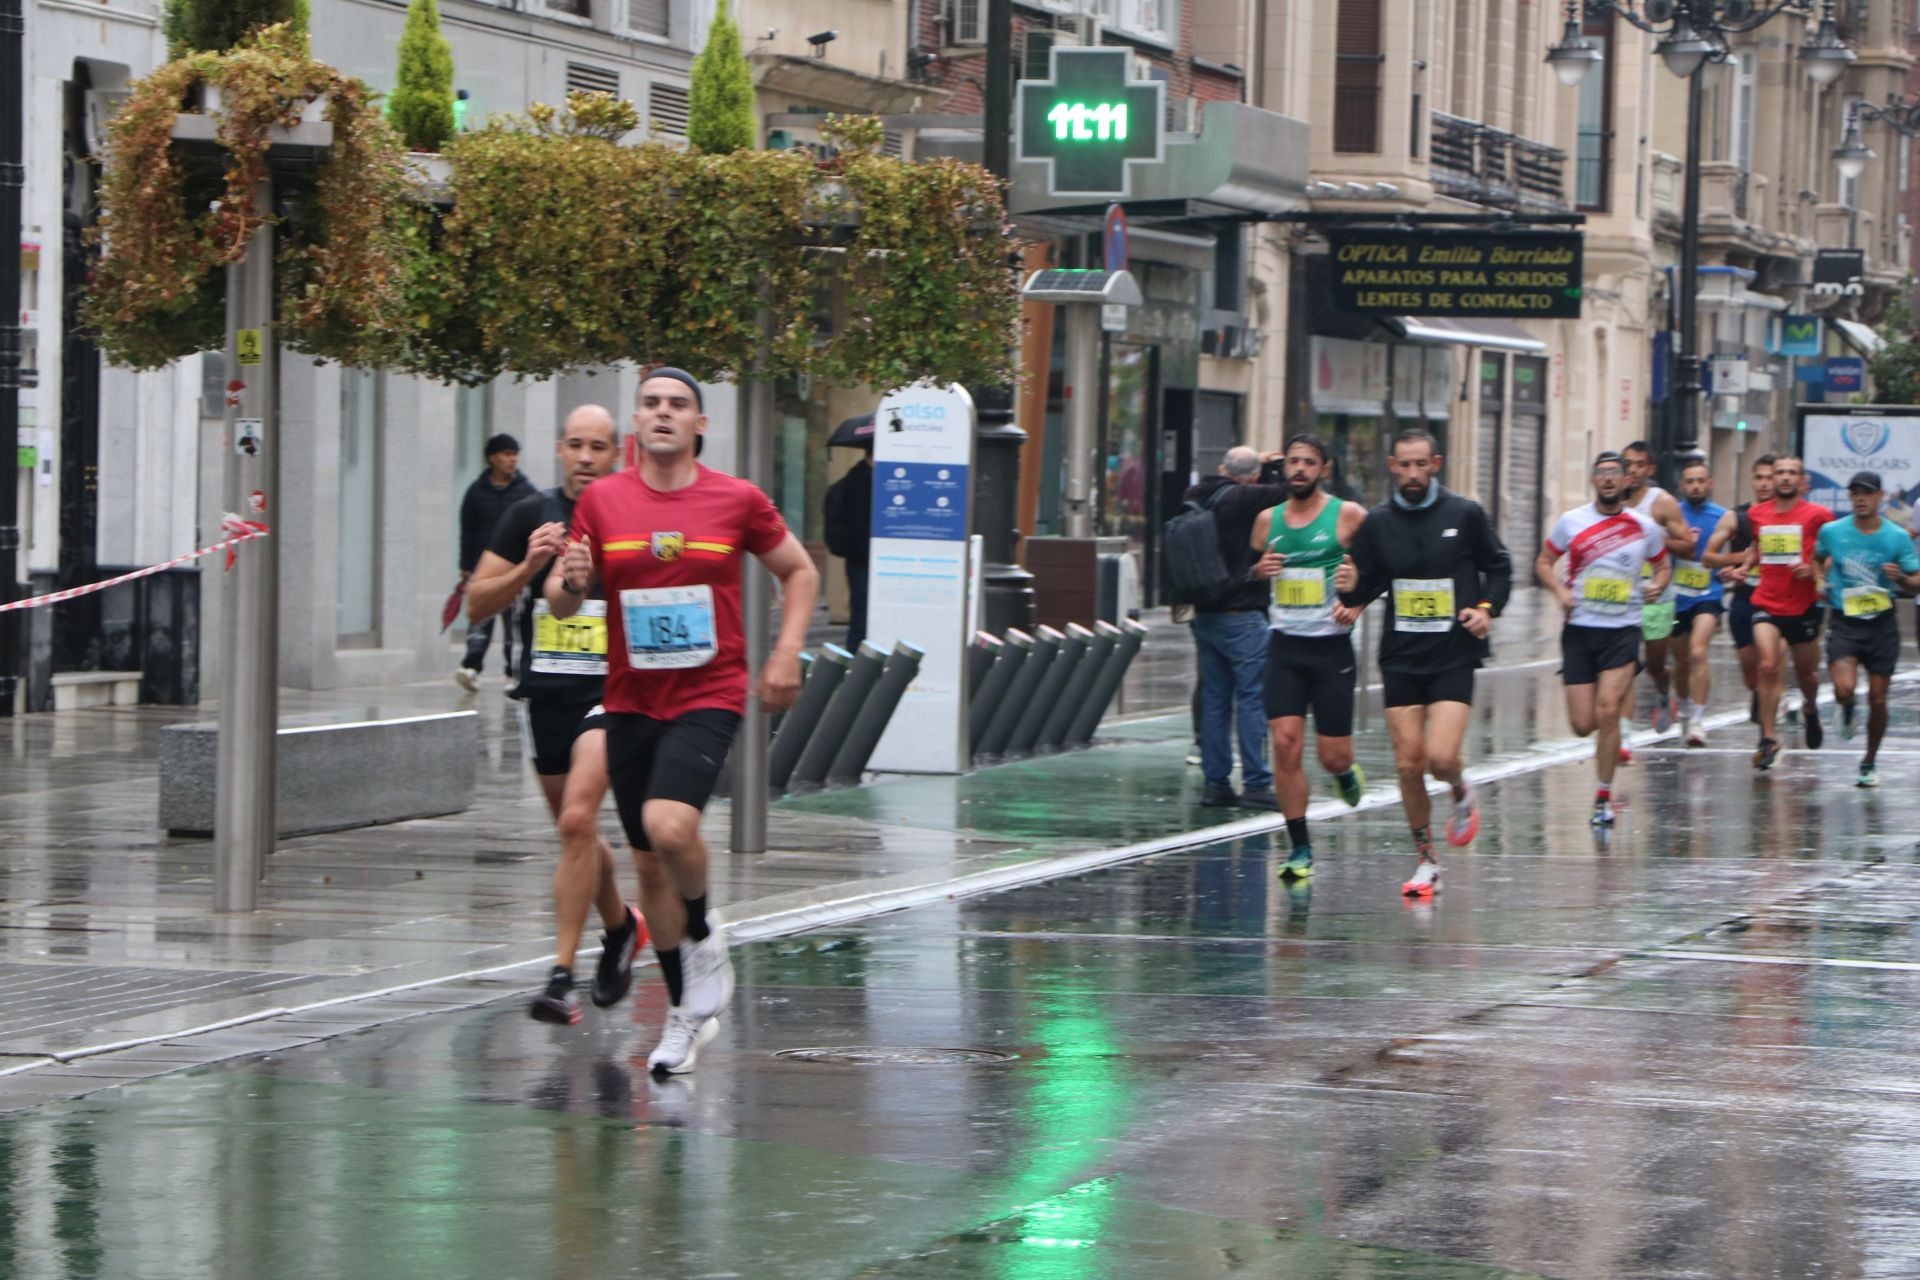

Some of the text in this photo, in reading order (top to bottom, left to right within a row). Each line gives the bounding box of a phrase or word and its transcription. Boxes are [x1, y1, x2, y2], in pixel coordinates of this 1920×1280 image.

[1047, 102, 1127, 139] 11:11
[1337, 244, 1574, 265] OPTICA Emilia Barriada
[1342, 269, 1569, 287] APARATOS PARA SORDOS
[1357, 292, 1553, 309] LENTES DE CONTACTO
[902, 403, 946, 419] alsa
[648, 614, 694, 645] 184
